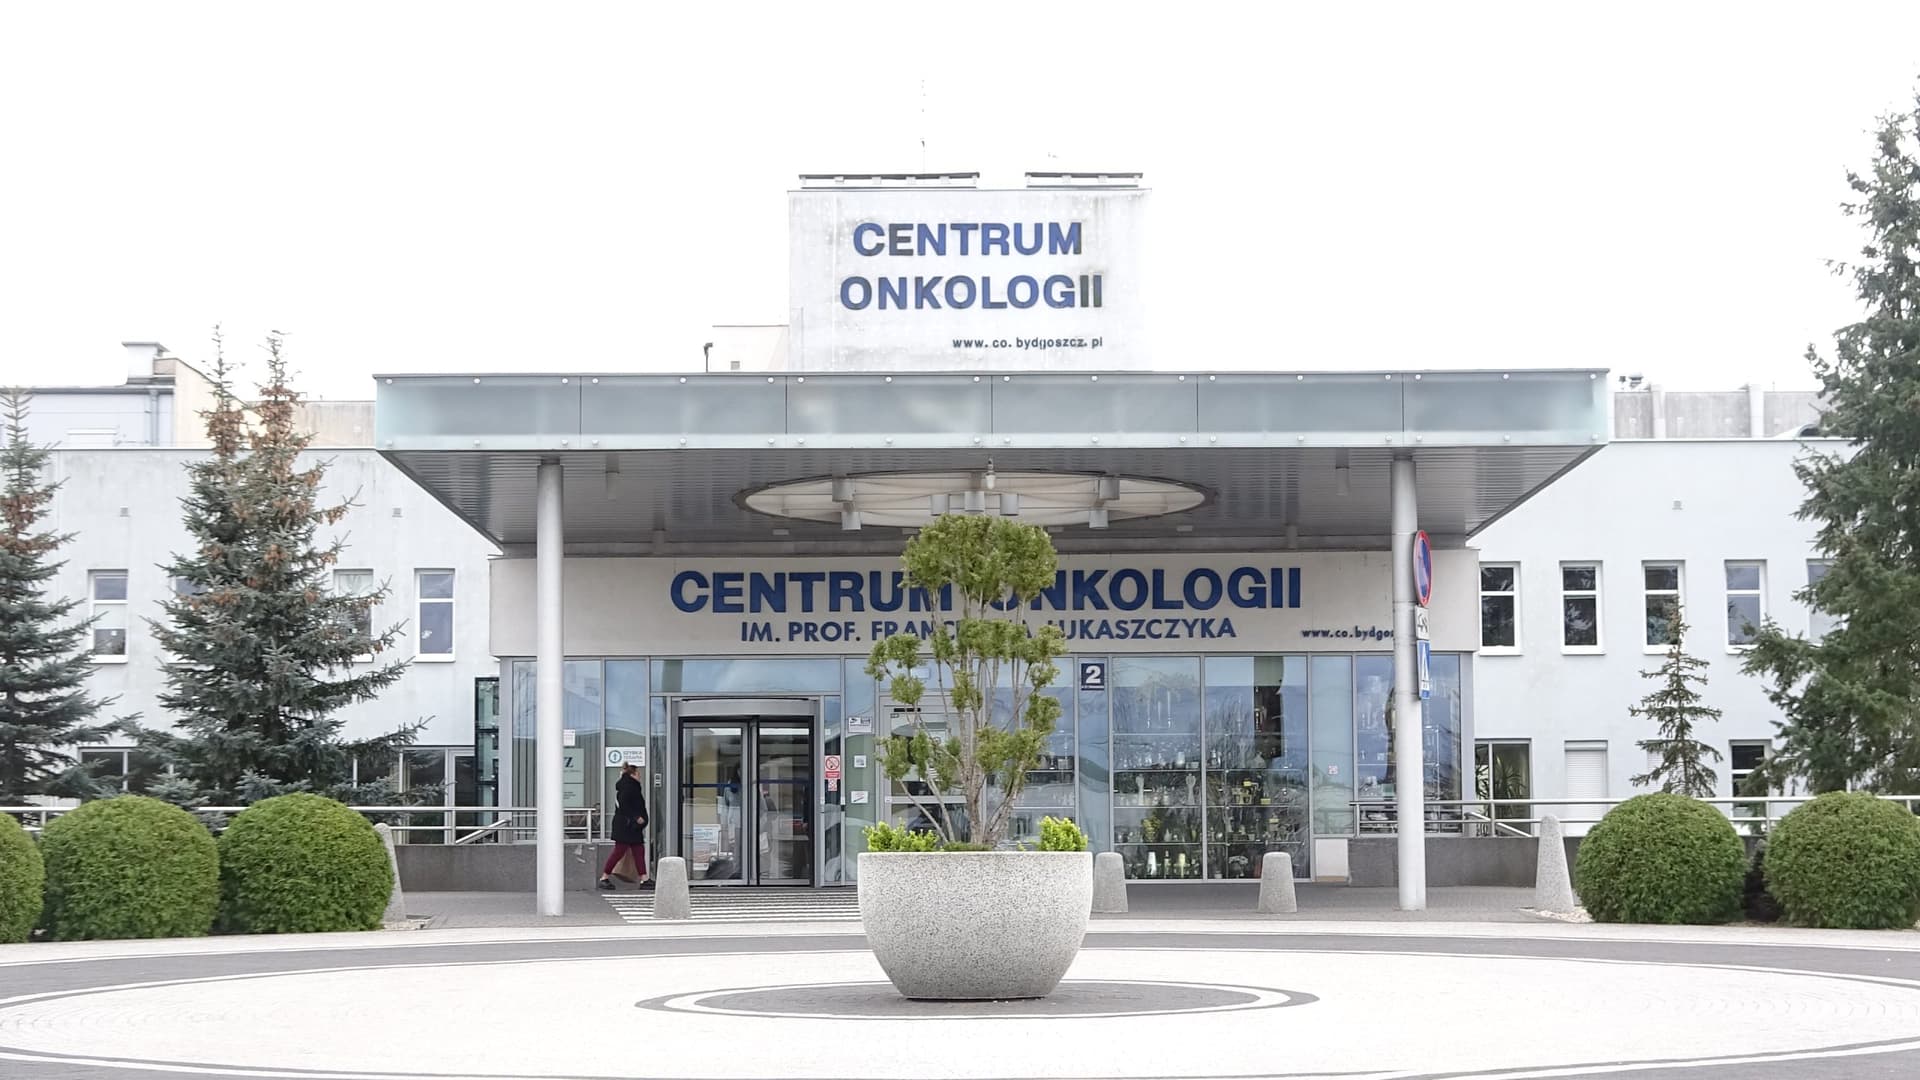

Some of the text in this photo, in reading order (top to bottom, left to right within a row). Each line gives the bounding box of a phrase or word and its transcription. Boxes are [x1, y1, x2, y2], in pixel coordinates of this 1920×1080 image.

[853, 222, 1082, 256] CENTRUM
[840, 274, 1103, 311] ONKOLOGII
[670, 570, 952, 613] CENTRUM
[741, 621, 780, 642] IM.
[788, 621, 861, 642] PROF.
[1047, 617, 1237, 640] UKASZCZYKA
[1085, 665, 1101, 684] 2
